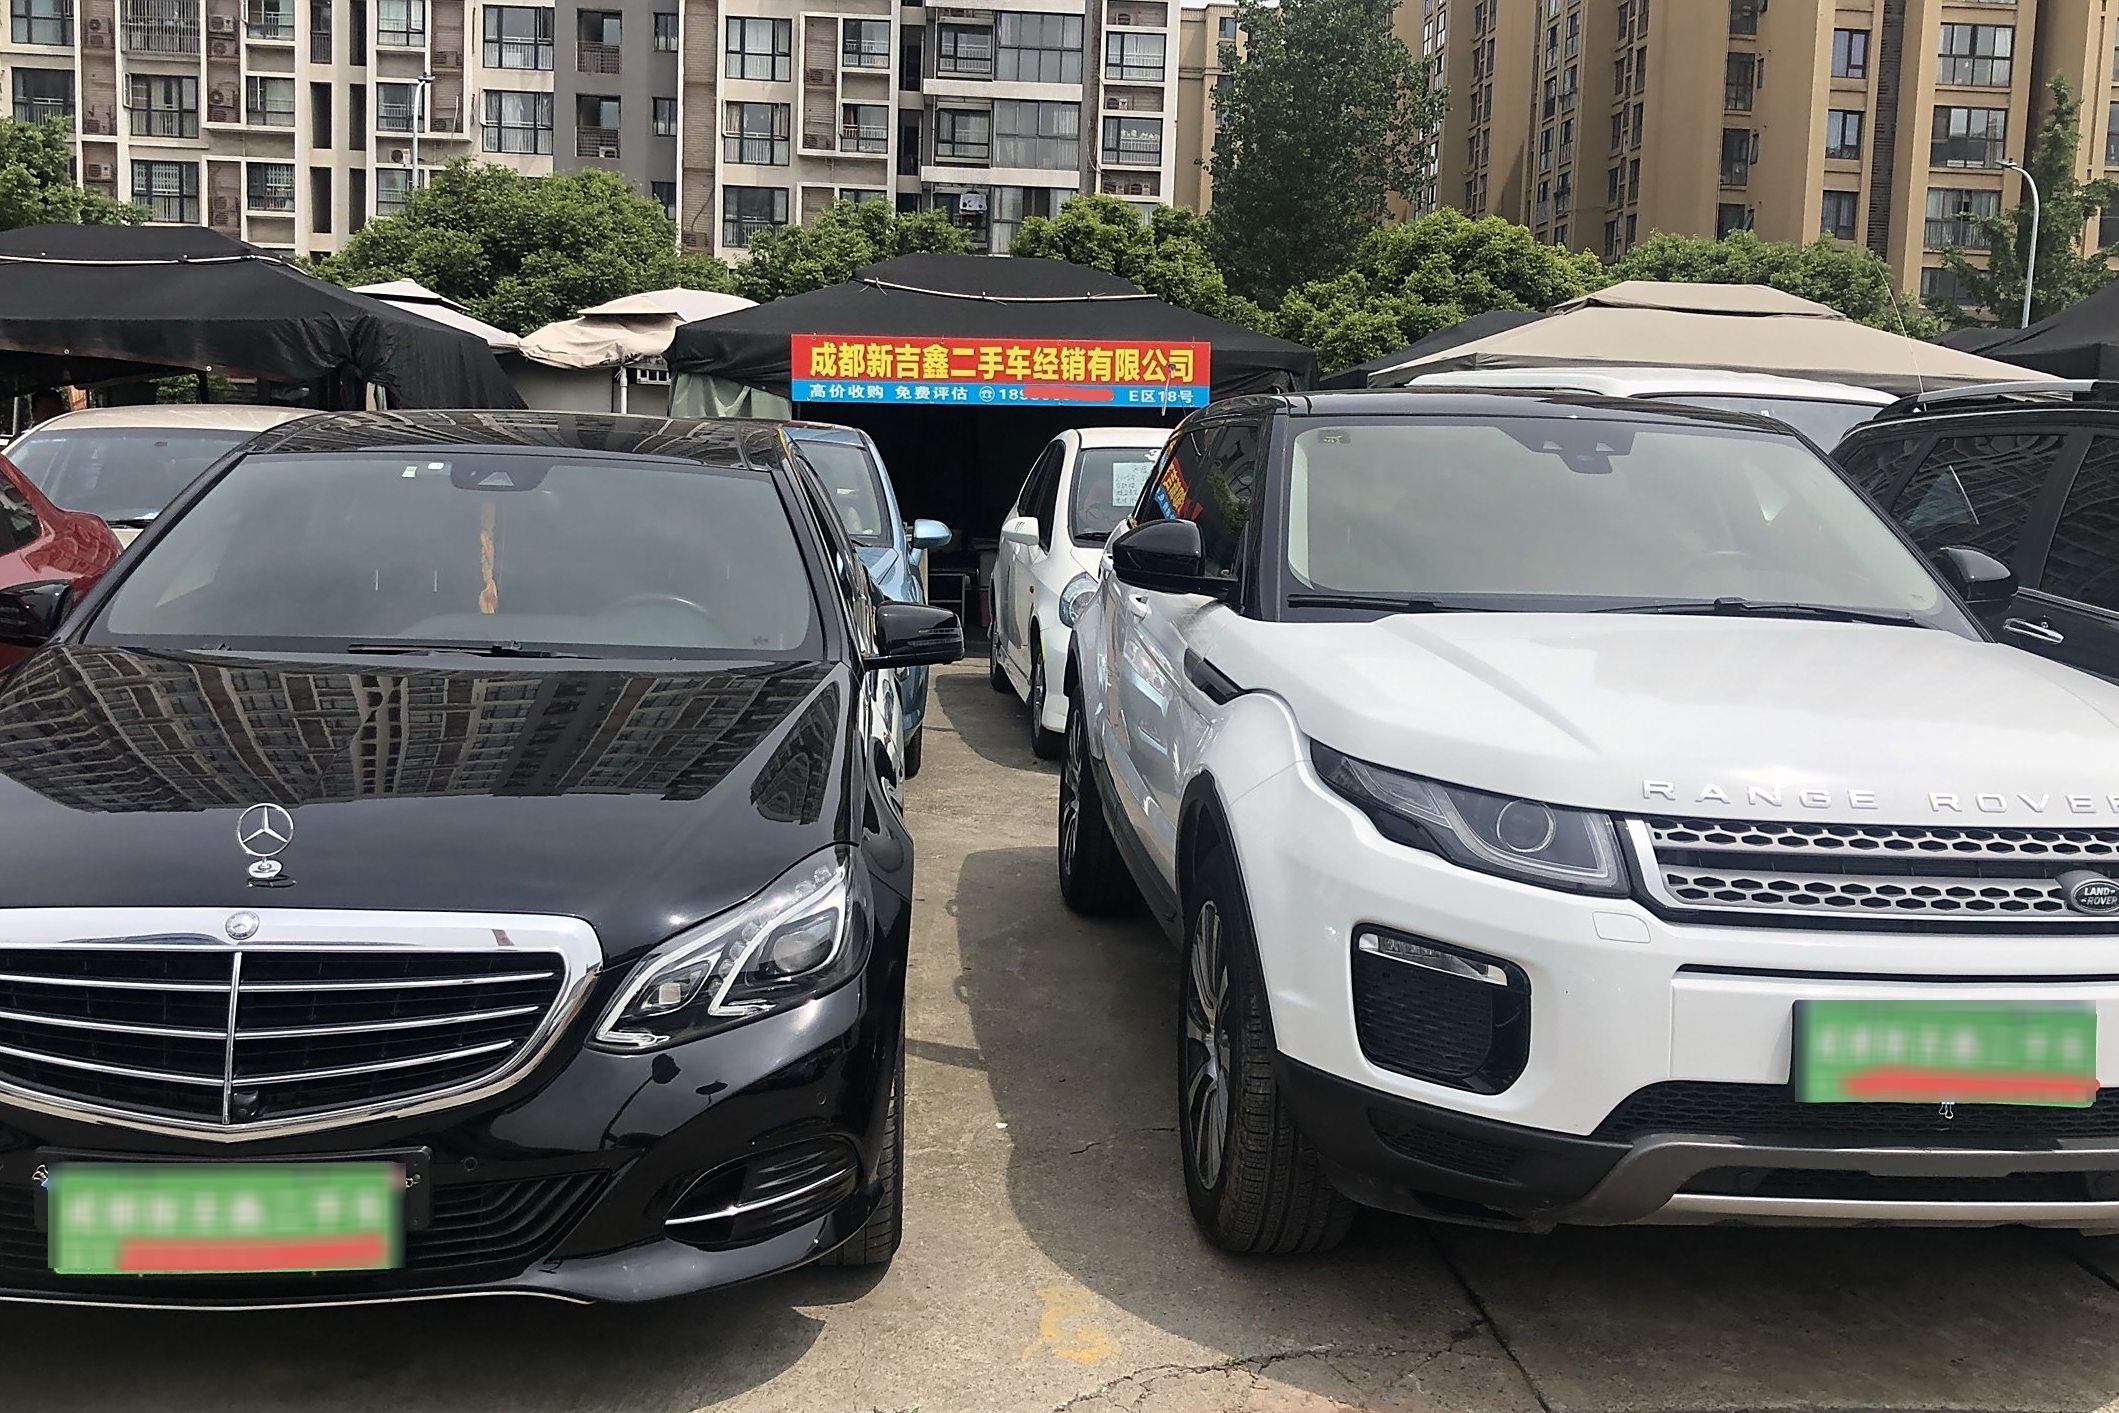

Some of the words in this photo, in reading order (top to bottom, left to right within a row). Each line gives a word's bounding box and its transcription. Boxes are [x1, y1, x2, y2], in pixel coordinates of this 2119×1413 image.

[809, 341, 1194, 383] 成都新吉鑫二手车经销有限公司
[809, 383, 884, 399] 高价收购
[895, 385, 968, 401] 免费评估
[1128, 389, 1194, 404] E区18号
[1641, 778, 1879, 809] RANGE
